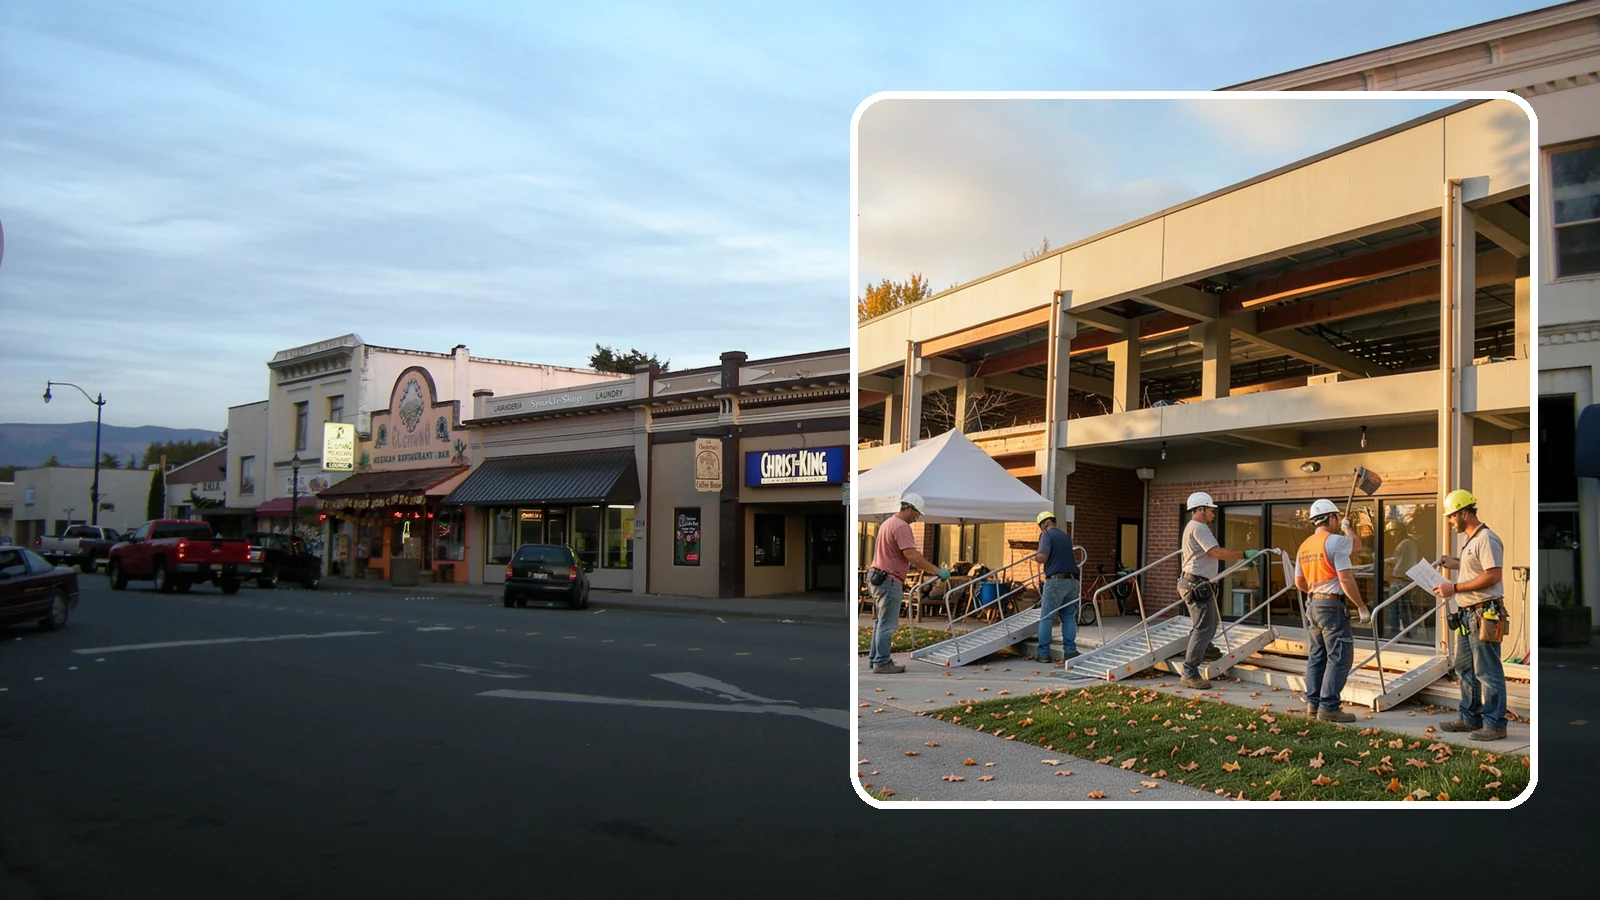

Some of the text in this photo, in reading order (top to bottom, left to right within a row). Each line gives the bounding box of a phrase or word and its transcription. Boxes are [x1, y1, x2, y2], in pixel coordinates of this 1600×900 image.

[530, 394, 582, 409] Sparkle Shop
[595, 389, 623, 400] LAUNDRY
[493, 402, 522, 412] LAVANDERIA
[374, 455, 397, 464] MEXICAN
[397, 451, 433, 462] RESTAURANT
[437, 450, 450, 459] BAR
[761, 450, 827, 478] CHRIST KING
